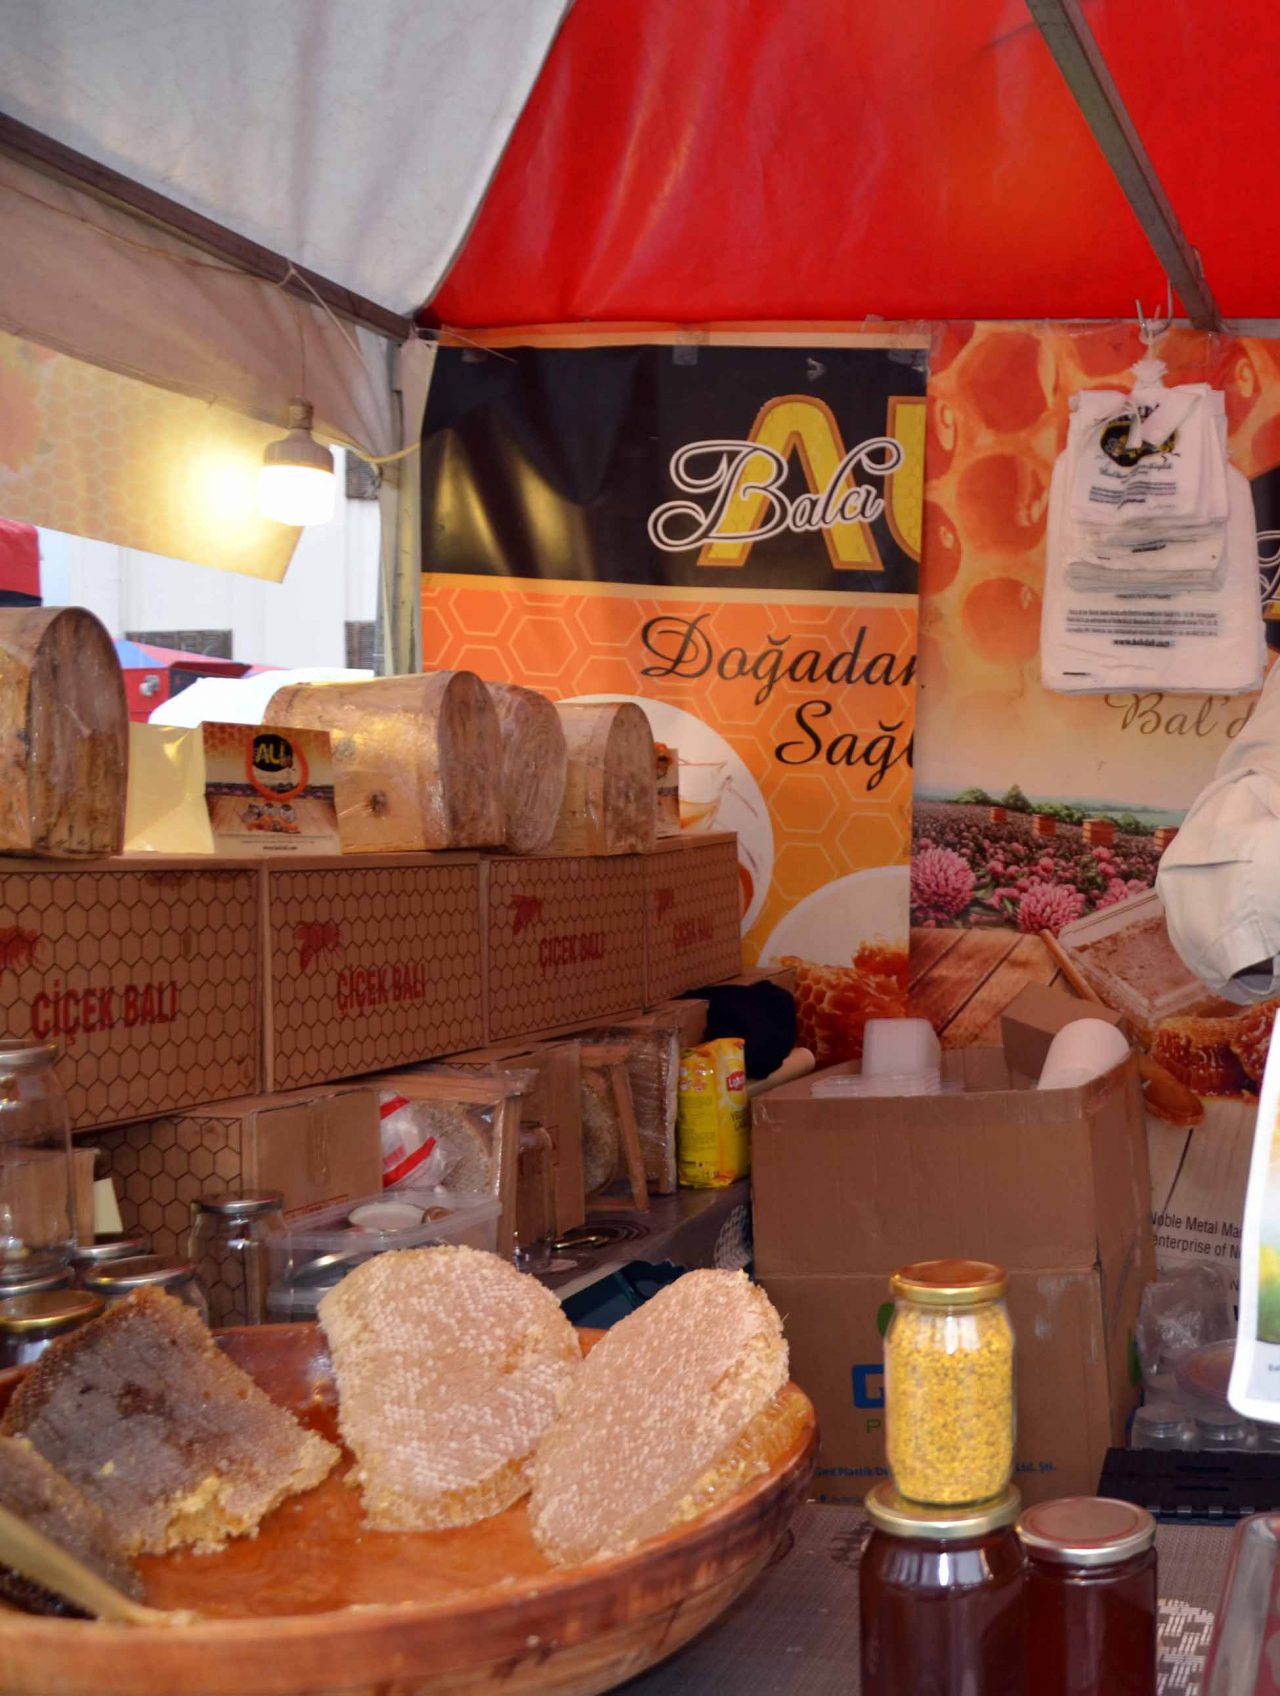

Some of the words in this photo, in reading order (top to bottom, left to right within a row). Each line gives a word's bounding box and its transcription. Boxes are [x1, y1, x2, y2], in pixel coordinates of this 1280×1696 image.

[124, 980, 178, 1028] BALI
[337, 963, 388, 1022] ÇİÇEK
[392, 963, 426, 1003] BALI
[1186, 1216, 1217, 1235] Metal
[1221, 1221, 1242, 1239] Ma
[1215, 1243, 1227, 1256] of
